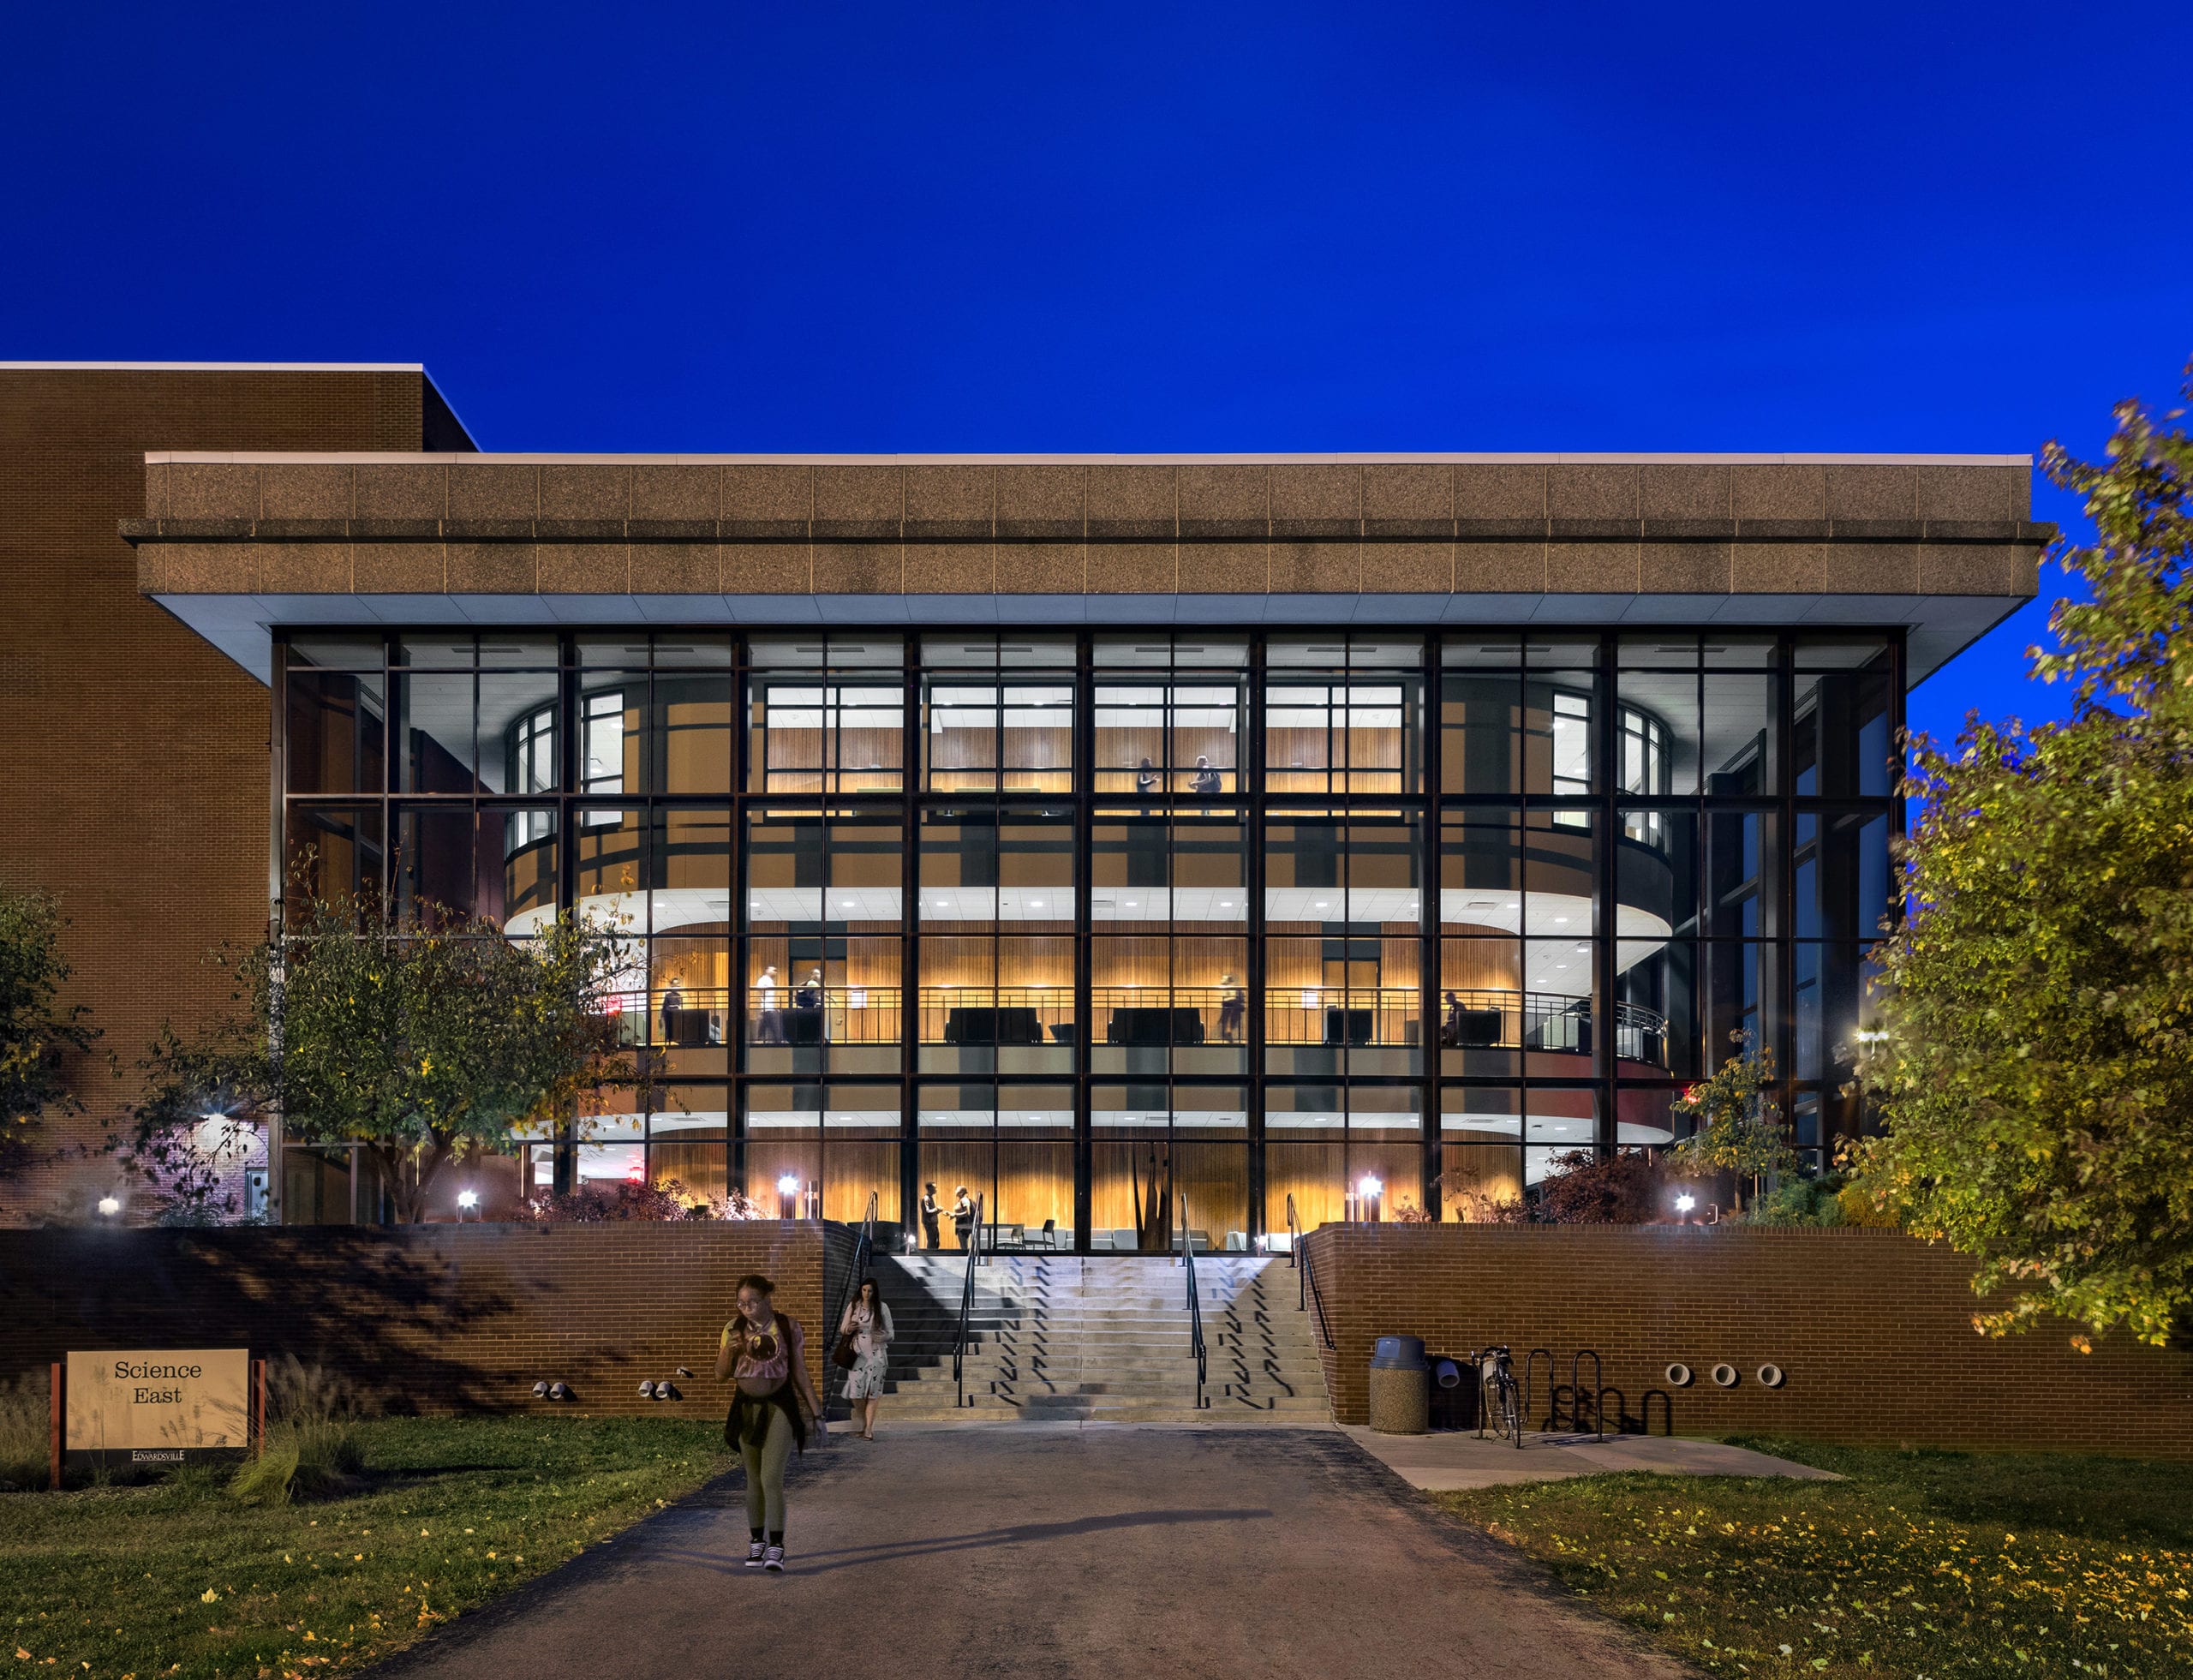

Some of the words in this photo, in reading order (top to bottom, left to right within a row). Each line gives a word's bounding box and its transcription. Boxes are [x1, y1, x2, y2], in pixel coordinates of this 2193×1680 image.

[115, 1361, 202, 1379] Science
[133, 1387, 182, 1404] East
[132, 1450, 185, 1462] EDWARDSVILLE
